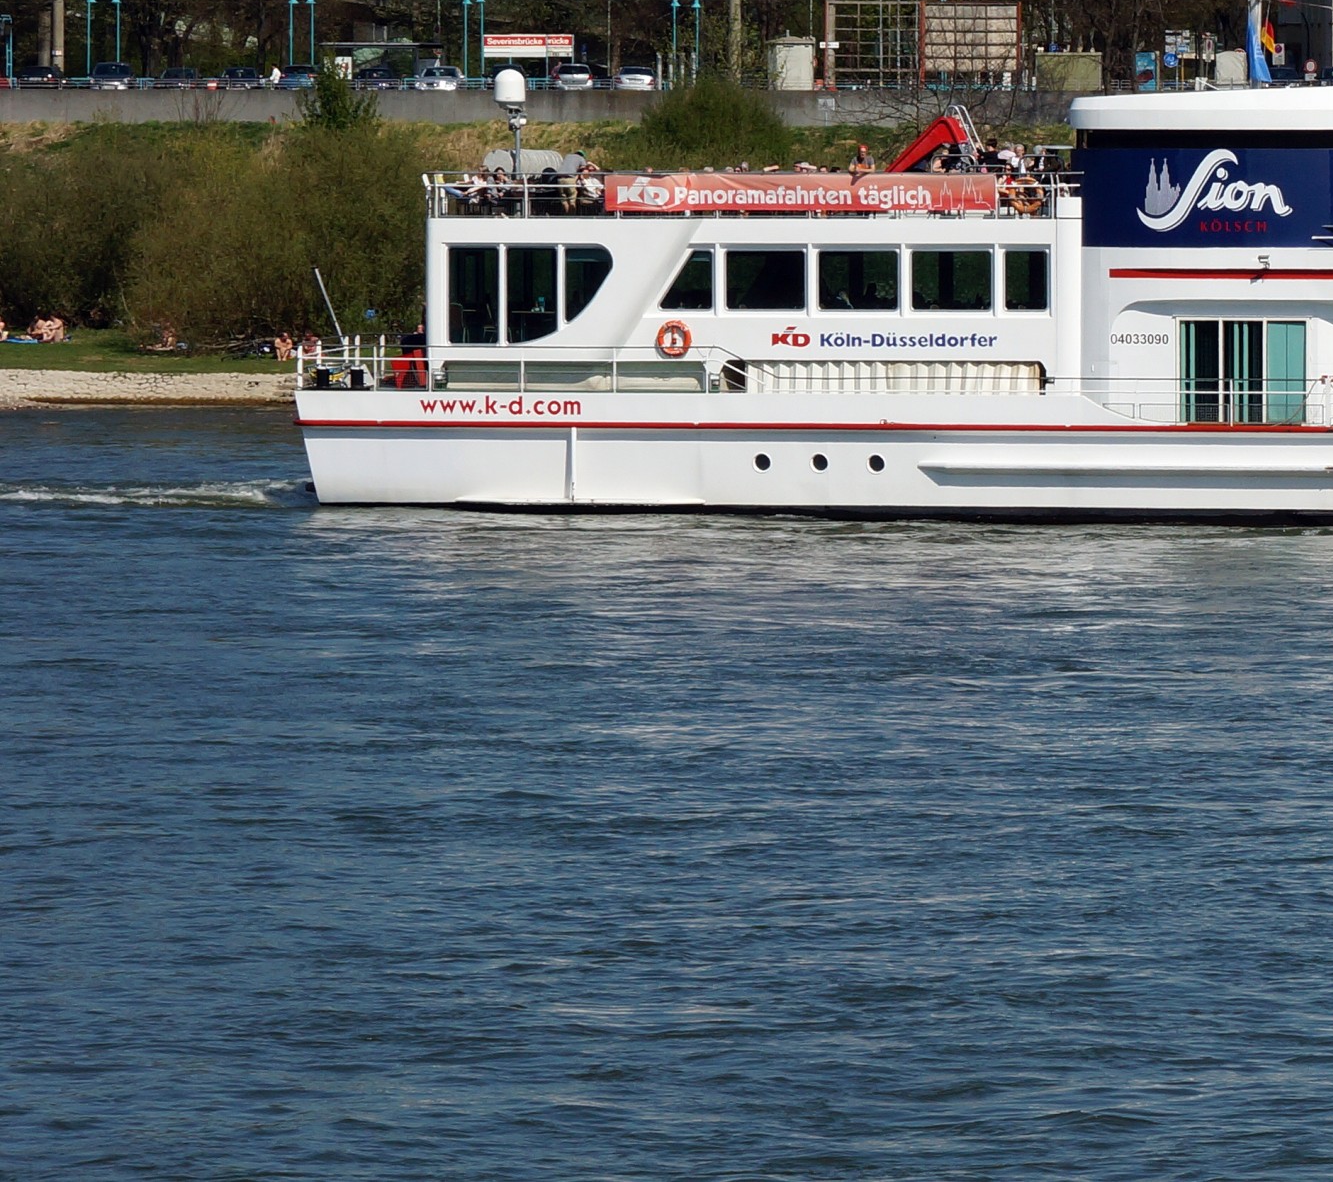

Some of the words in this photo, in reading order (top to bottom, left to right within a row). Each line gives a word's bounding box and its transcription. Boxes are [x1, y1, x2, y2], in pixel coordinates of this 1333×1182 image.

[486, 37, 543, 46] Severinsbrücke
[617, 184, 670, 206] KD
[674, 185, 852, 206] Panoramafahrten
[857, 184, 932, 209] täglich
[1136, 148, 1293, 233] Sion
[1200, 219, 1267, 233] KÖLSCH
[771, 332, 811, 348] KD
[819, 331, 998, 348] Köln-Düsseldorfer
[1110, 333, 1169, 345] 04033090
[419, 395, 582, 416] www.k-d.com
